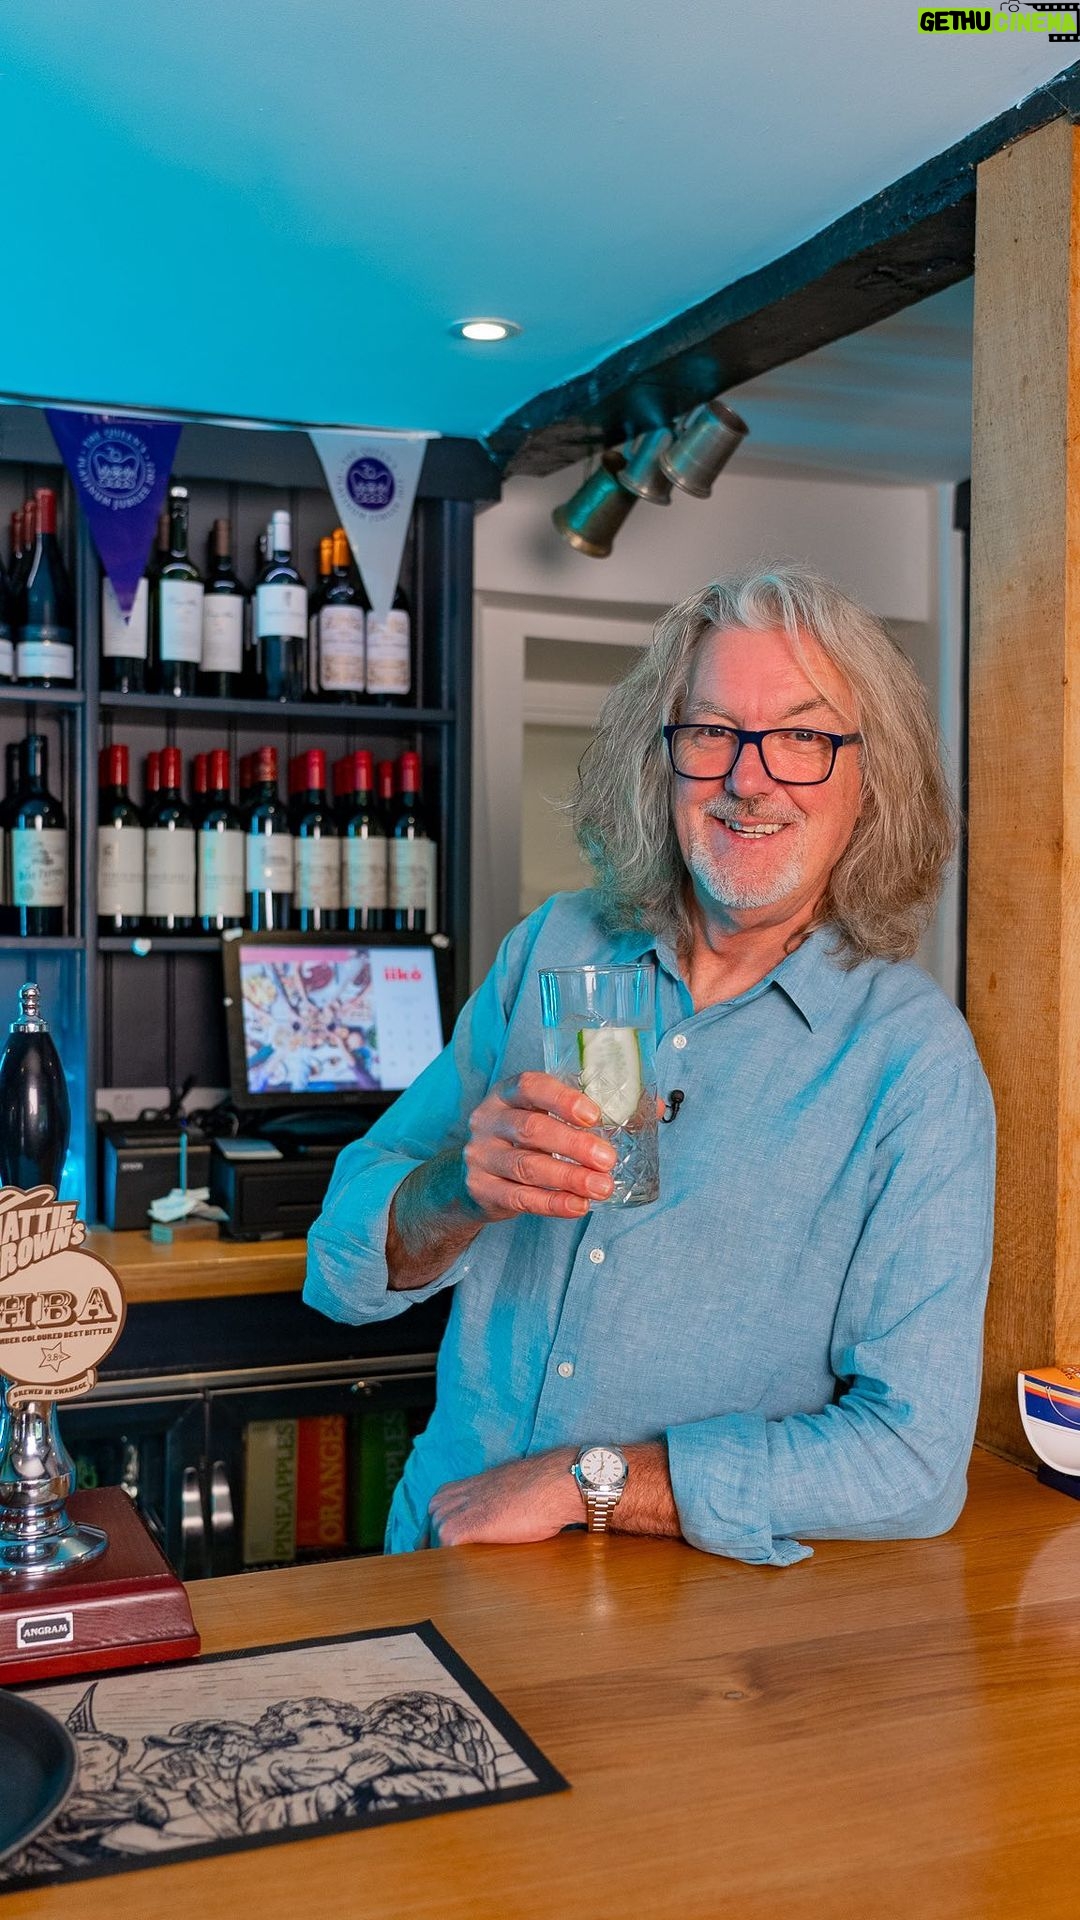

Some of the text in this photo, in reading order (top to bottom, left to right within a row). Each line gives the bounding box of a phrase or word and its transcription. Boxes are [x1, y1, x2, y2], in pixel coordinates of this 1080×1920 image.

[0, 1204, 76, 1245] ATTIE
[0, 1222, 85, 1278] ROWN'S
[0, 1327, 113, 1344] MBER COLOURED BEST BITTER
[13, 1388, 44, 1398] BREWED
[53, 1381, 88, 1395] SWANAGE
[274, 1422, 295, 1557] PINEAPPLES
[320, 1415, 343, 1543] ORANGES
[23, 1623, 68, 1638] ANGRAM
